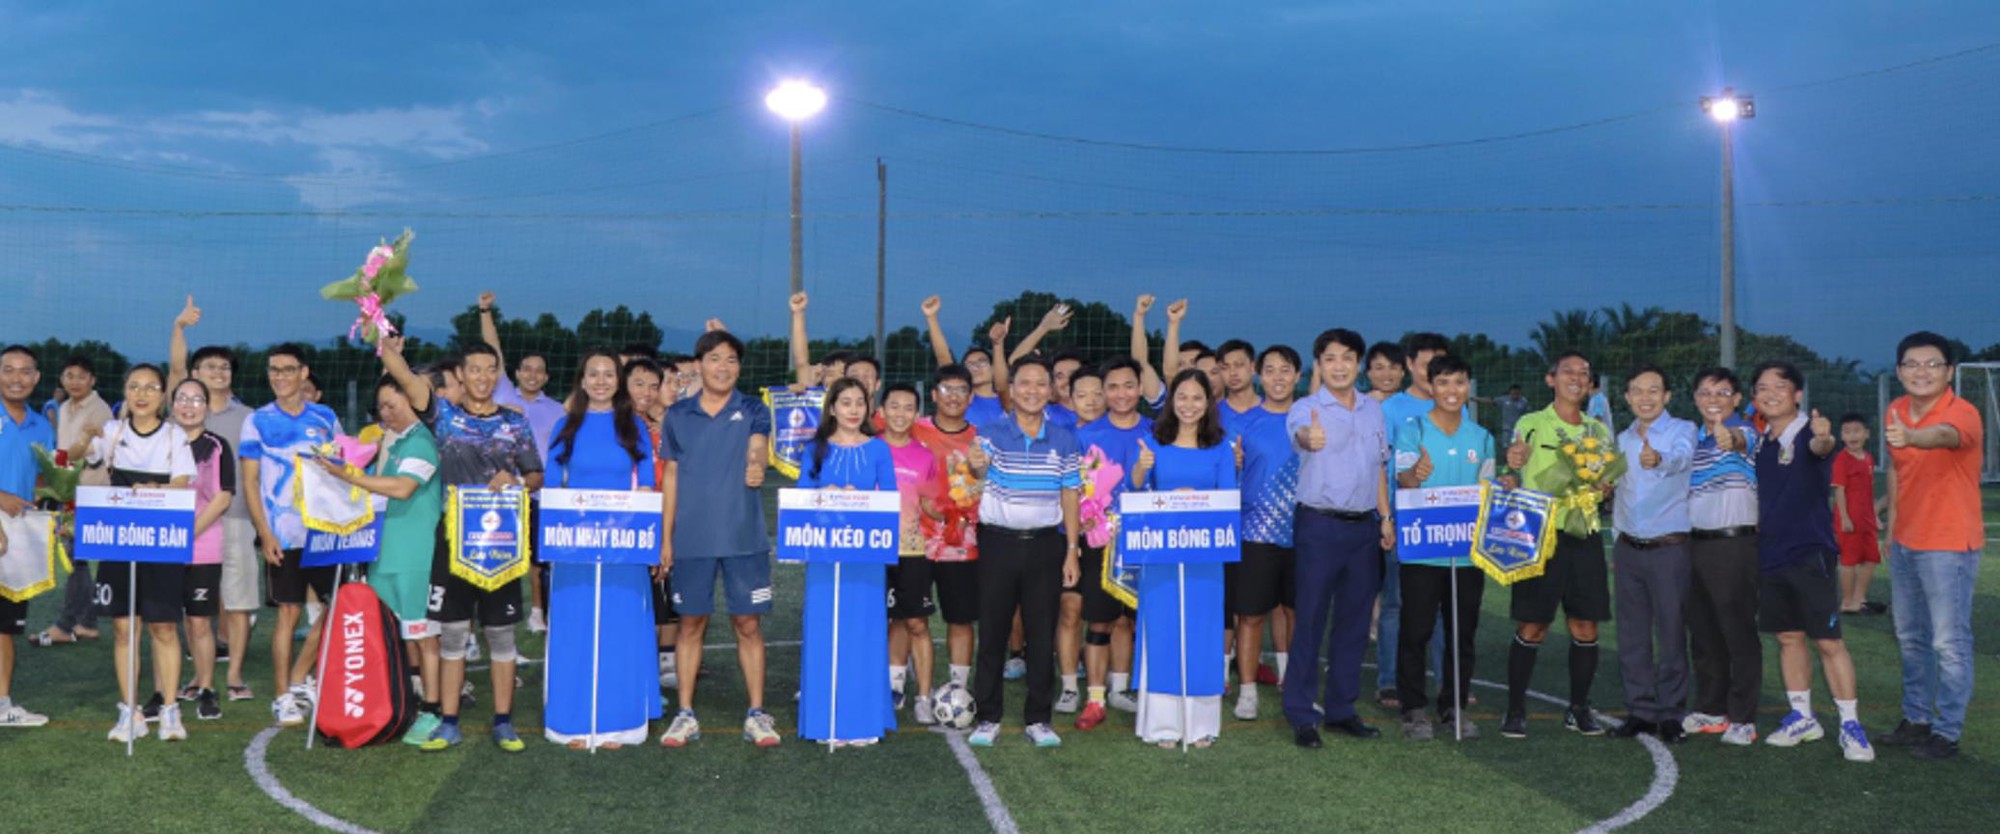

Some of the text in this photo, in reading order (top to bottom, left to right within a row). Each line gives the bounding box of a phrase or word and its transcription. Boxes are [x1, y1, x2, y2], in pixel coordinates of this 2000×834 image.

[82, 520, 188, 548] MÔN BÓNG BÀN
[545, 522, 573, 547] MÔN
[611, 528, 635, 549] BAO
[638, 522, 656, 549] BỐ
[785, 522, 893, 549] MÔN KÉO CO
[1126, 523, 1236, 550] MÔN BÓNG ĐÁ
[343, 611, 365, 685] YONEX
